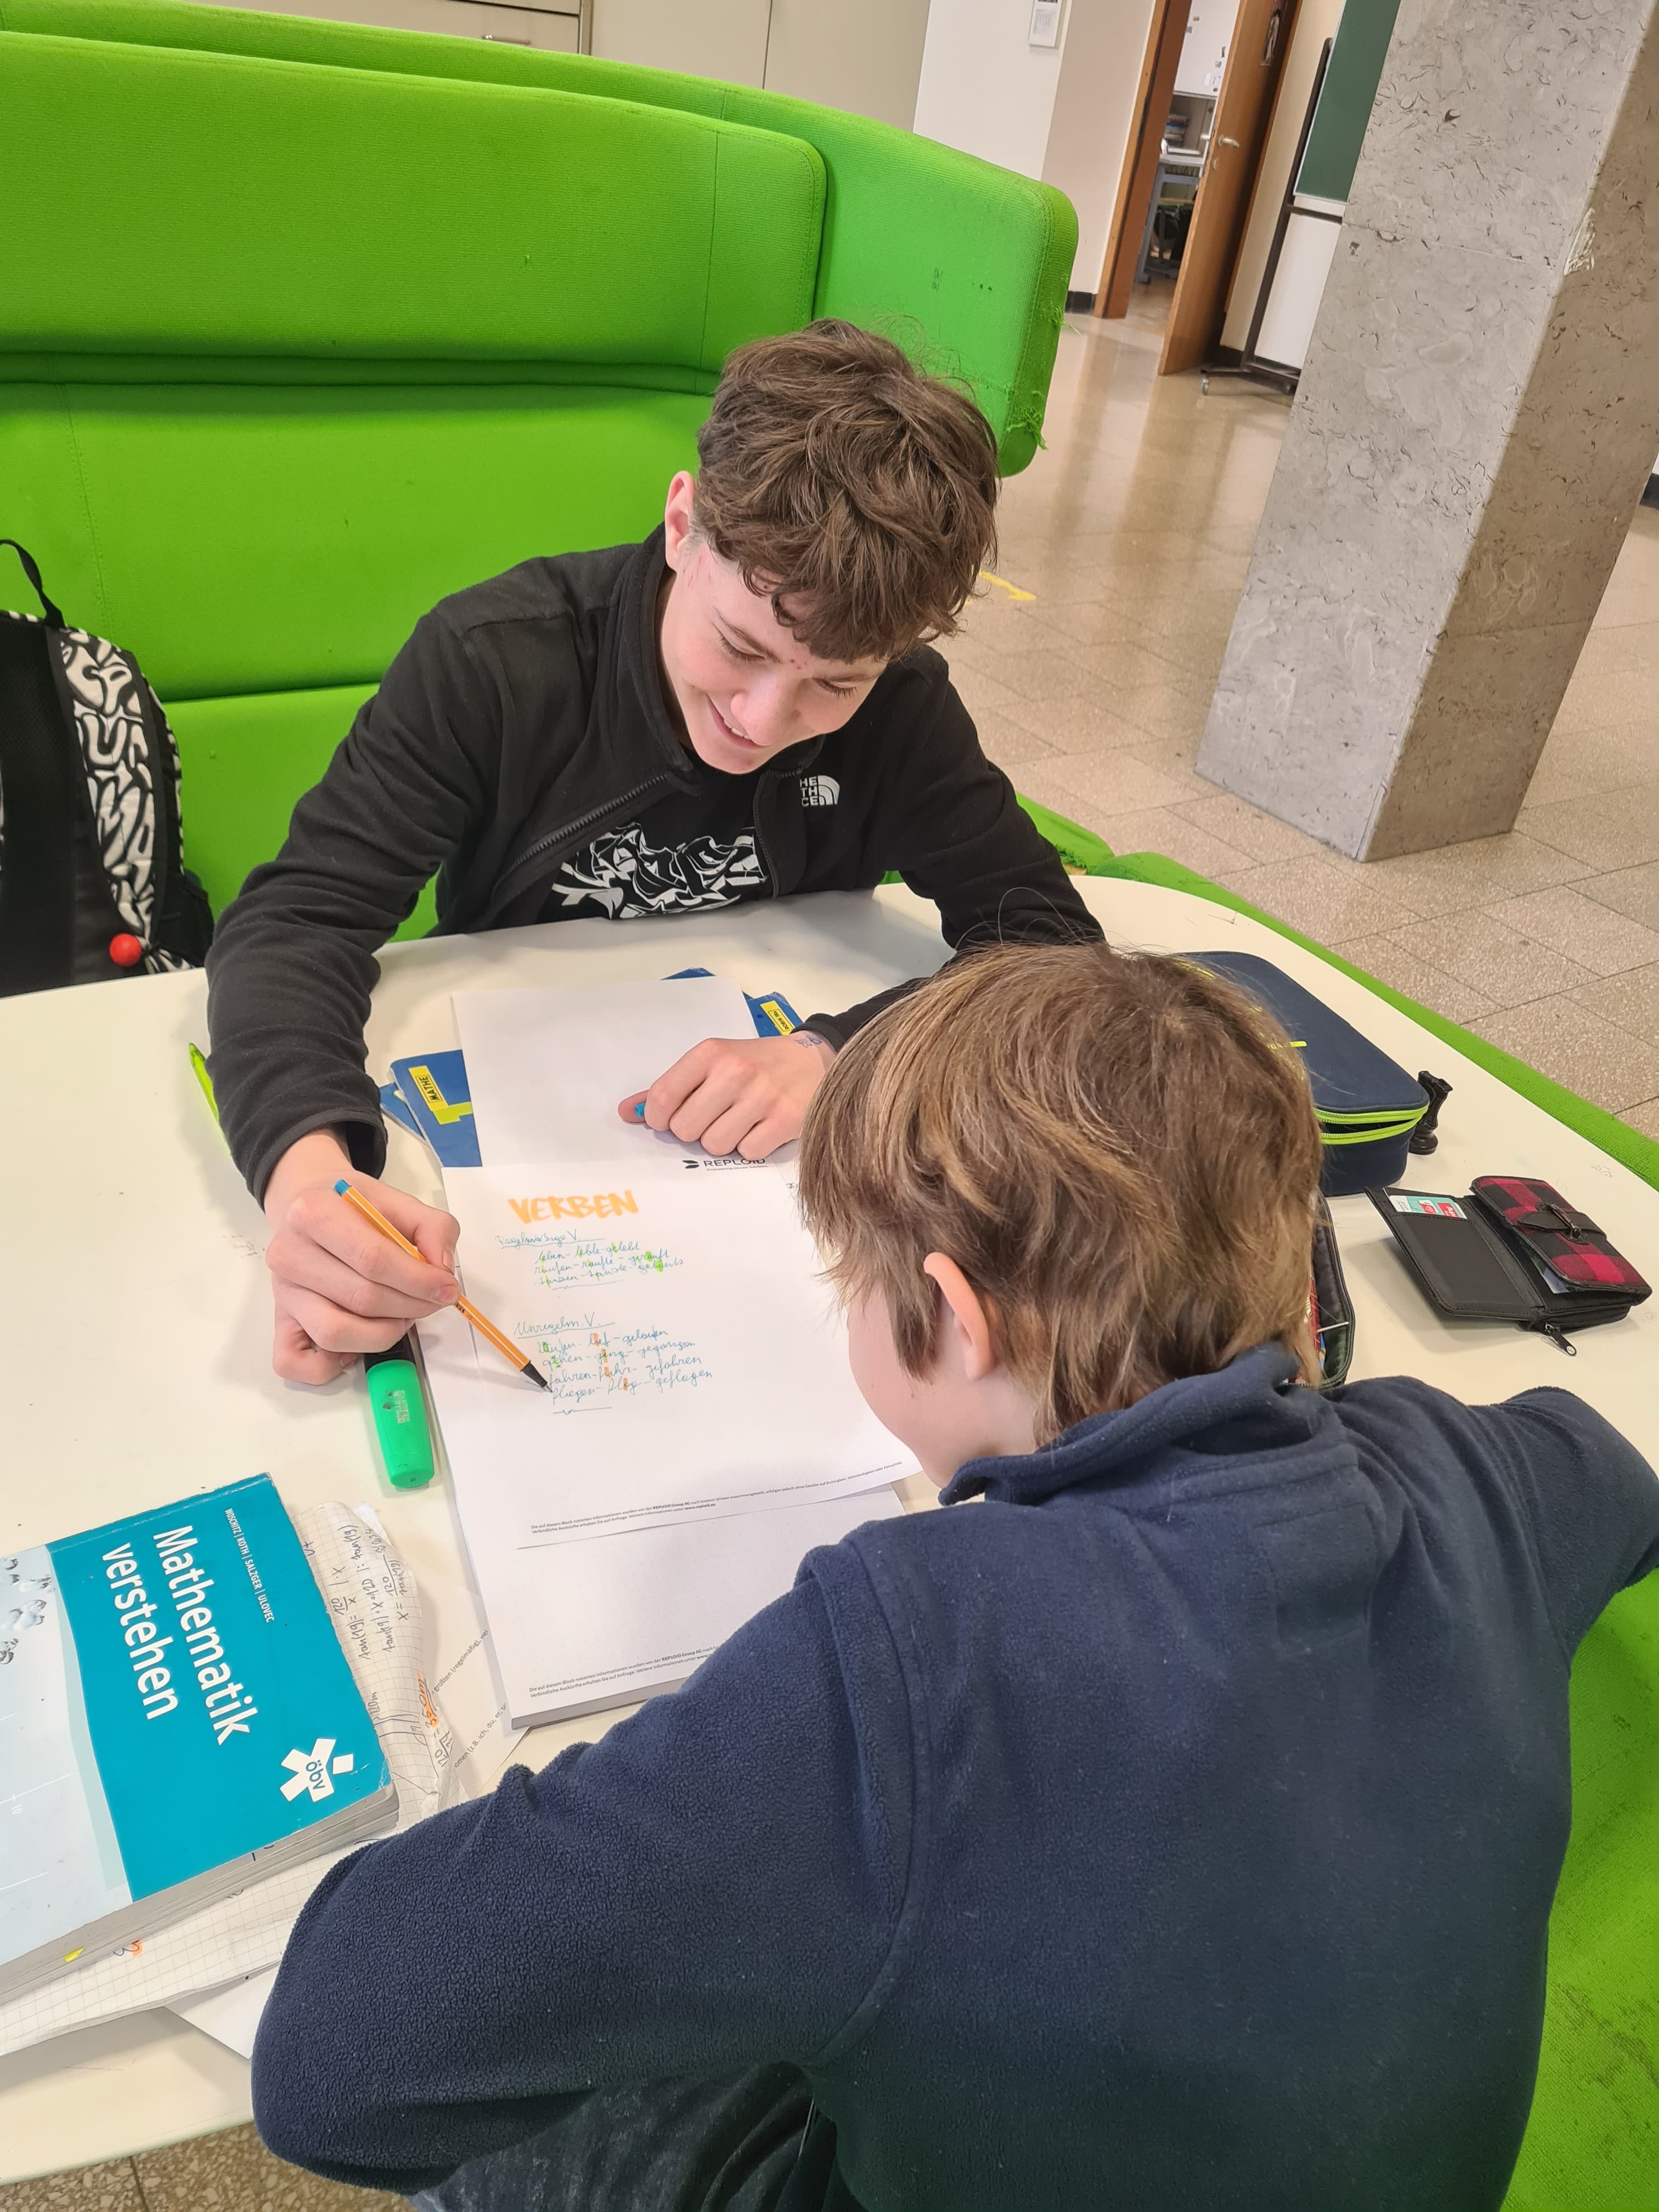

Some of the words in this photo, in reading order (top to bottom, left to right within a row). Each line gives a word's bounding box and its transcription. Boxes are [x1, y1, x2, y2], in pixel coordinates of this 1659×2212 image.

[800, 776, 817, 787] HE
[419, 1076, 440, 1101] MATHE
[703, 1159, 765, 1167] REPLOID
[508, 1190, 639, 1224] VERBEN
[224, 1508, 242, 1534] WOSCHITZ
[236, 1537, 250, 1555] KOTH
[245, 1559, 263, 1590] SALZGER
[258, 1594, 274, 1623] ULOVEC
[102, 1542, 179, 1720] verstehen
[153, 1525, 258, 1746] Mathematik
[305, 1759, 325, 1790] öbv
